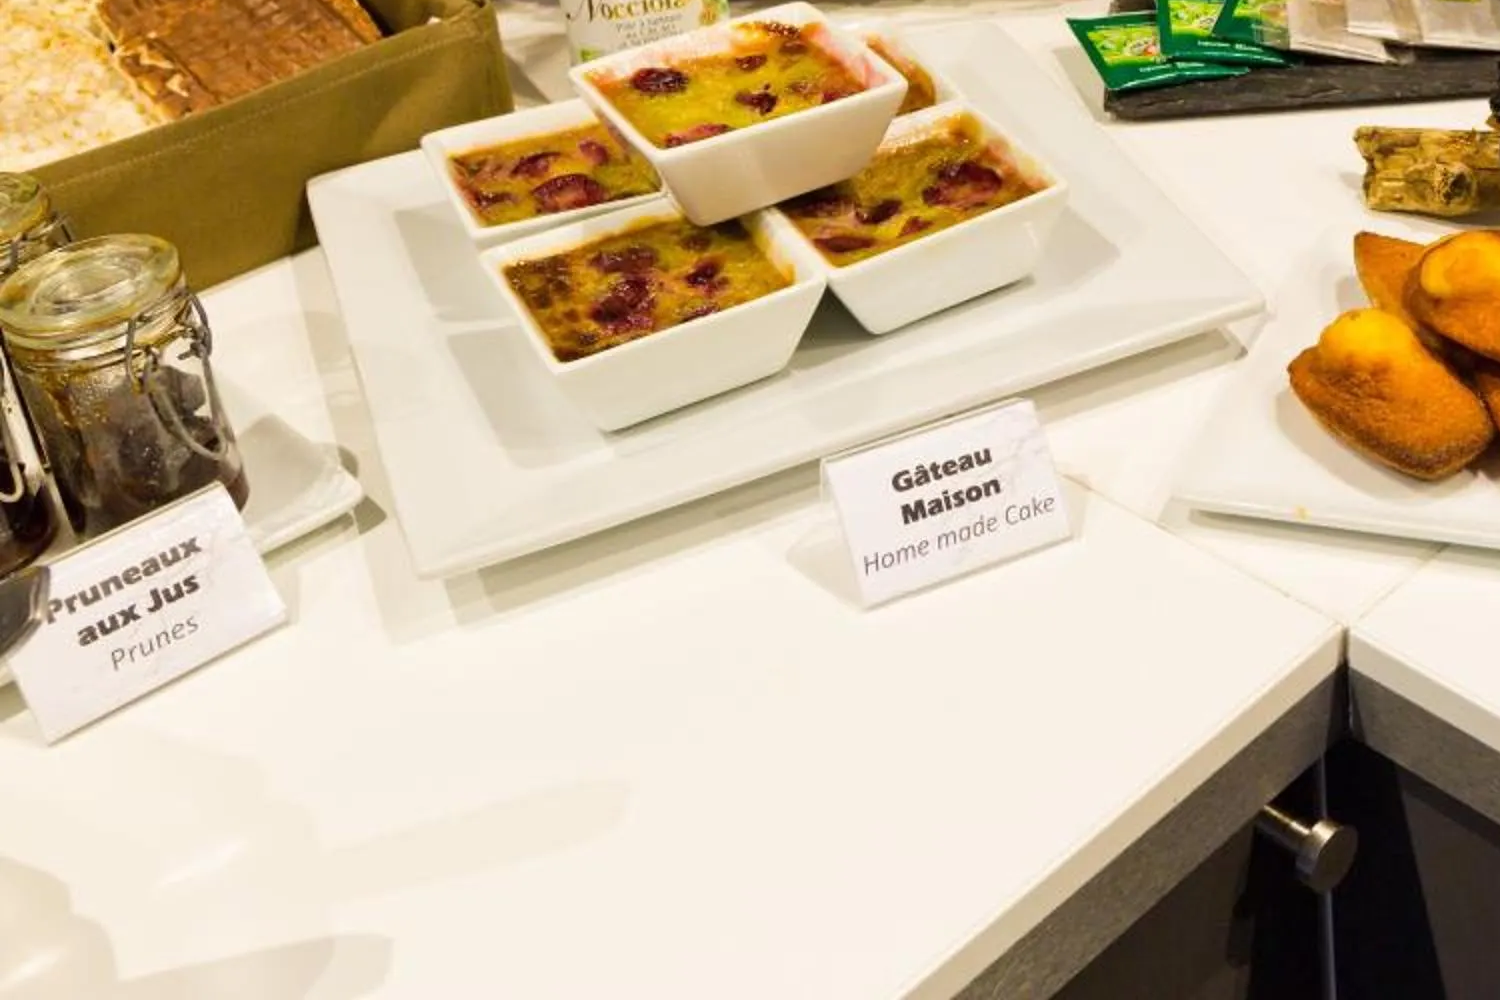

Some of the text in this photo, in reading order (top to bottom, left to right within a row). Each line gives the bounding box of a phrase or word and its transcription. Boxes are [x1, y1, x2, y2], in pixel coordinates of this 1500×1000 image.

[891, 448, 993, 492] Gâteau
[900, 478, 1001, 525] Maison
[863, 496, 1055, 577] Home made Cake
[46, 536, 202, 624] Pruneaux
[77, 574, 200, 647] aux Jus
[110, 615, 199, 672] Prunes
